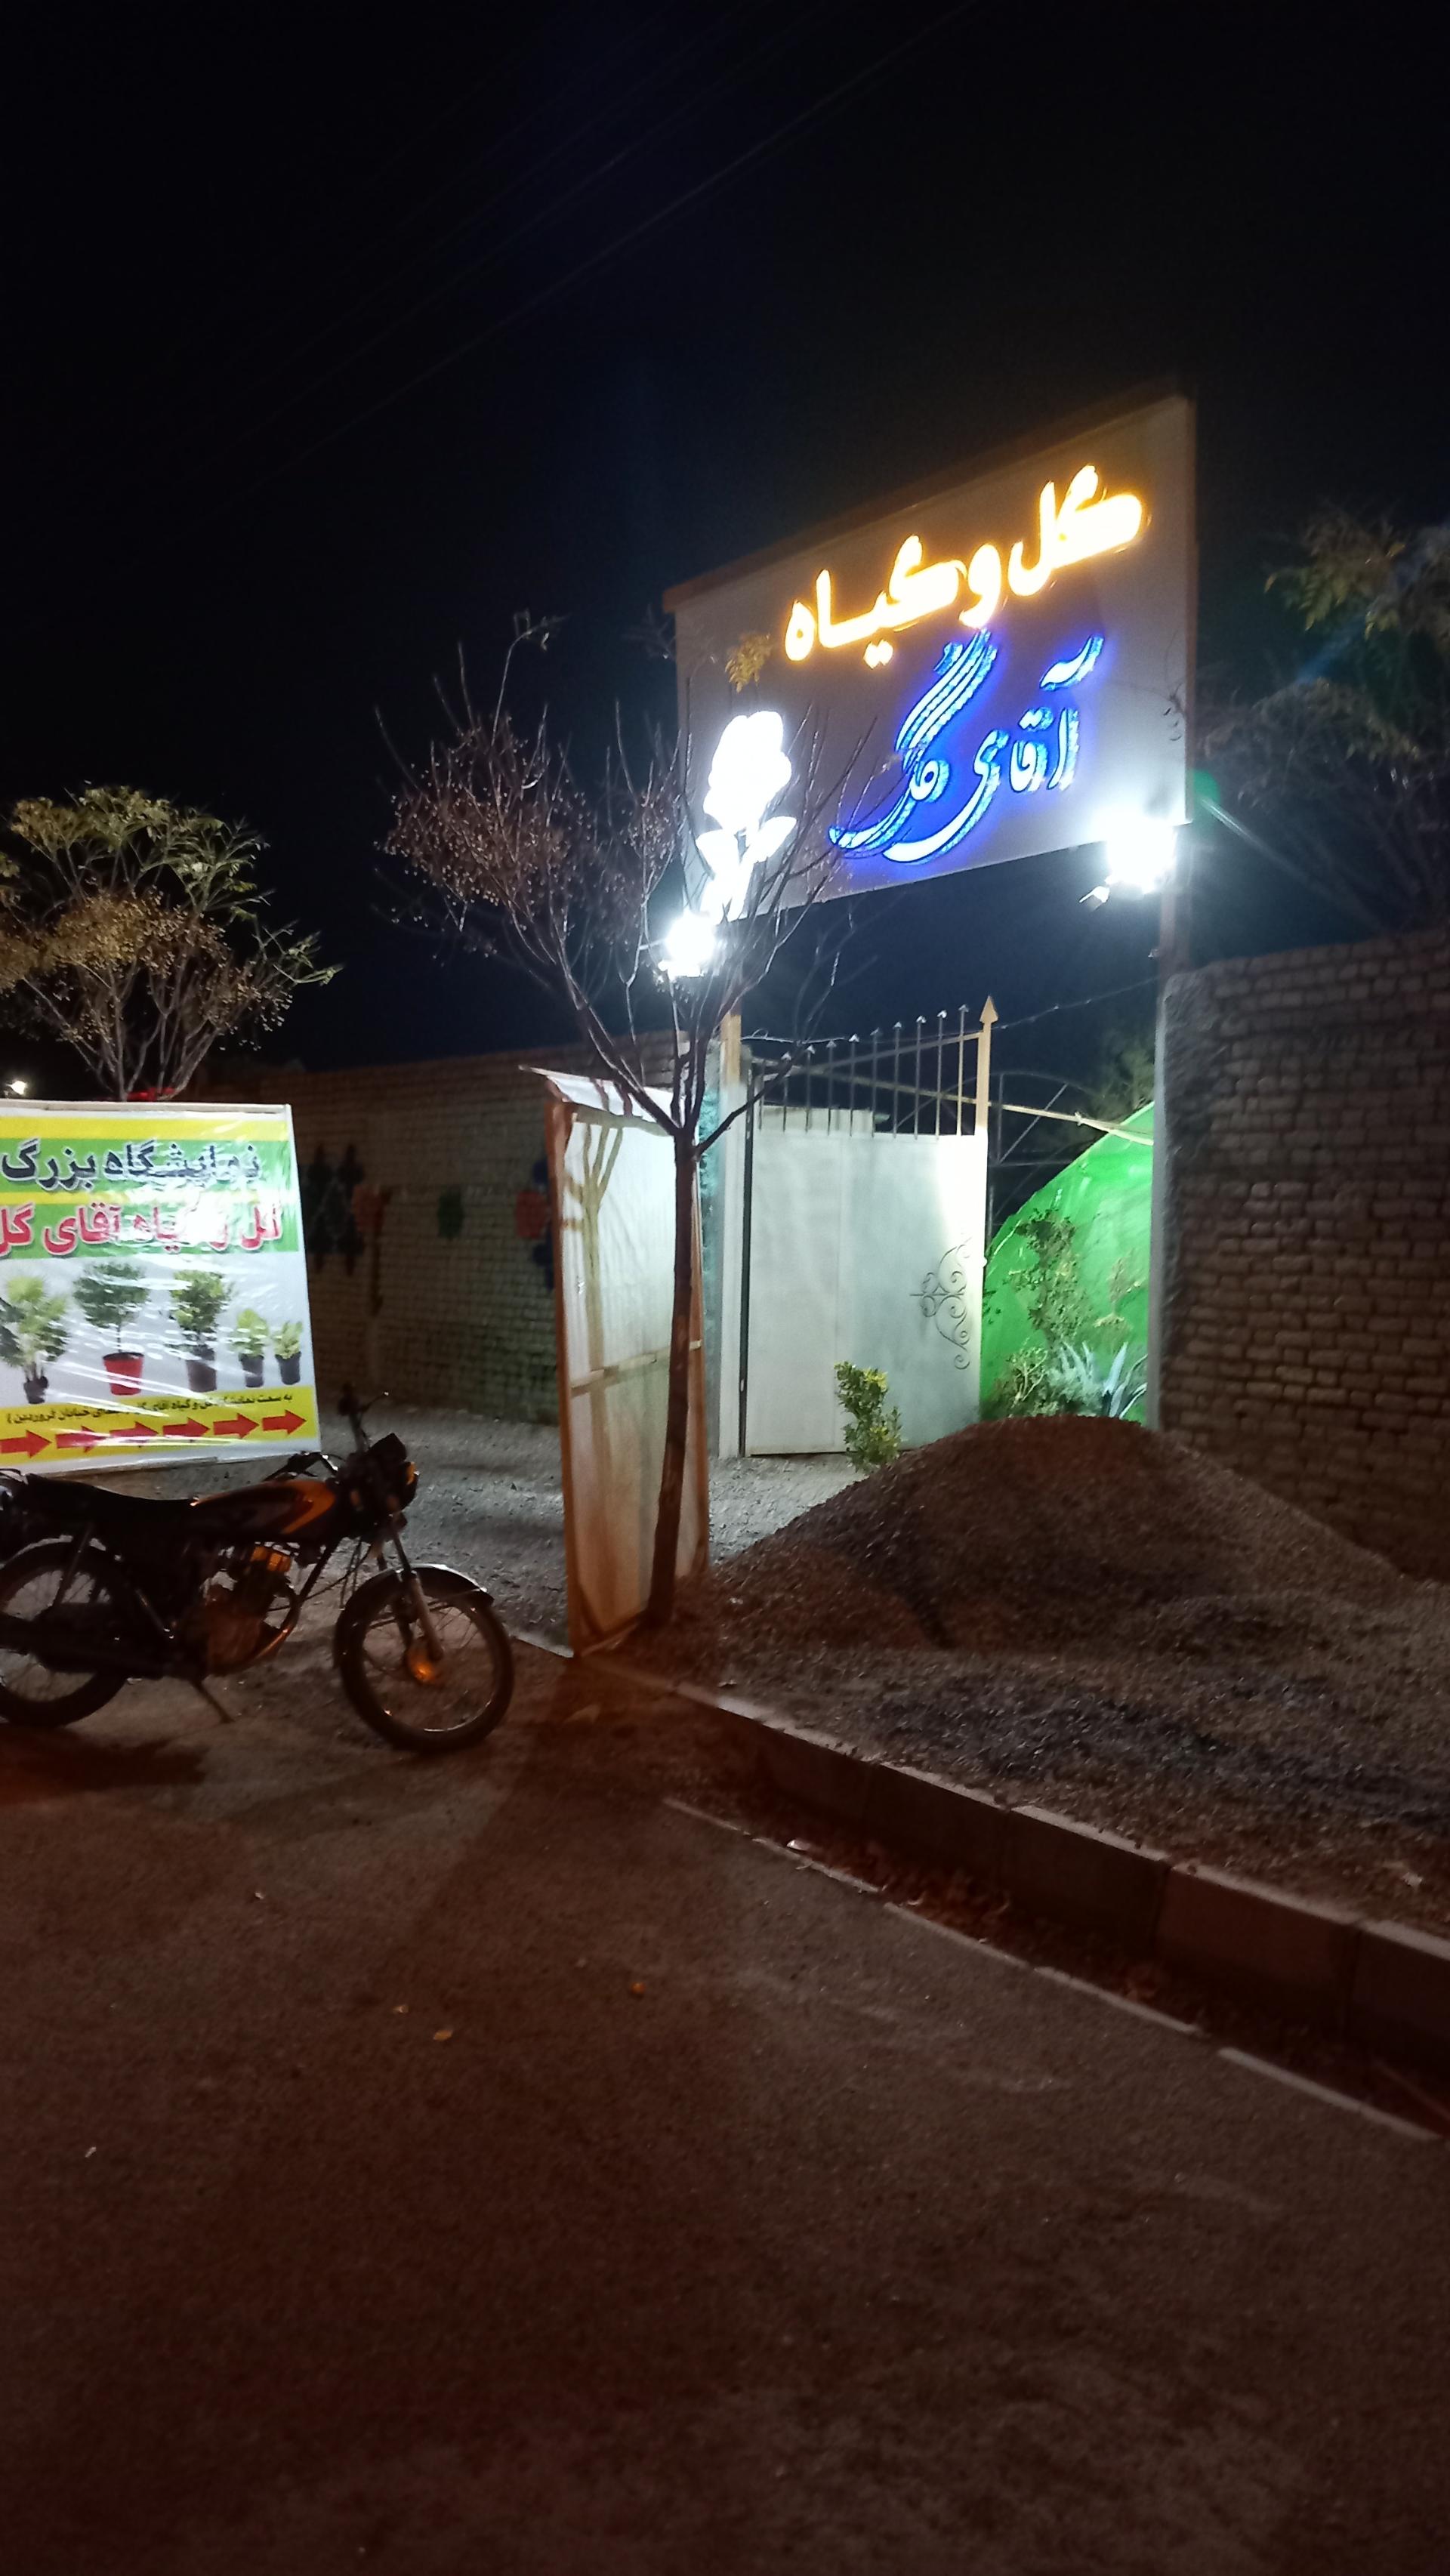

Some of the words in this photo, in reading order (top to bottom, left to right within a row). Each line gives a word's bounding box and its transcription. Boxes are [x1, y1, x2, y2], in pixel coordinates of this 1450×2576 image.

[1008, 464, 1143, 597] گل
[784, 534, 966, 669] گیاه
[959, 542, 1002, 629] و
[882, 634, 1105, 865] آقای
[1, 1138, 97, 1192] بزرگ
[103, 1138, 261, 1188] نمایشگاه
[44, 1202, 122, 1255] آقای
